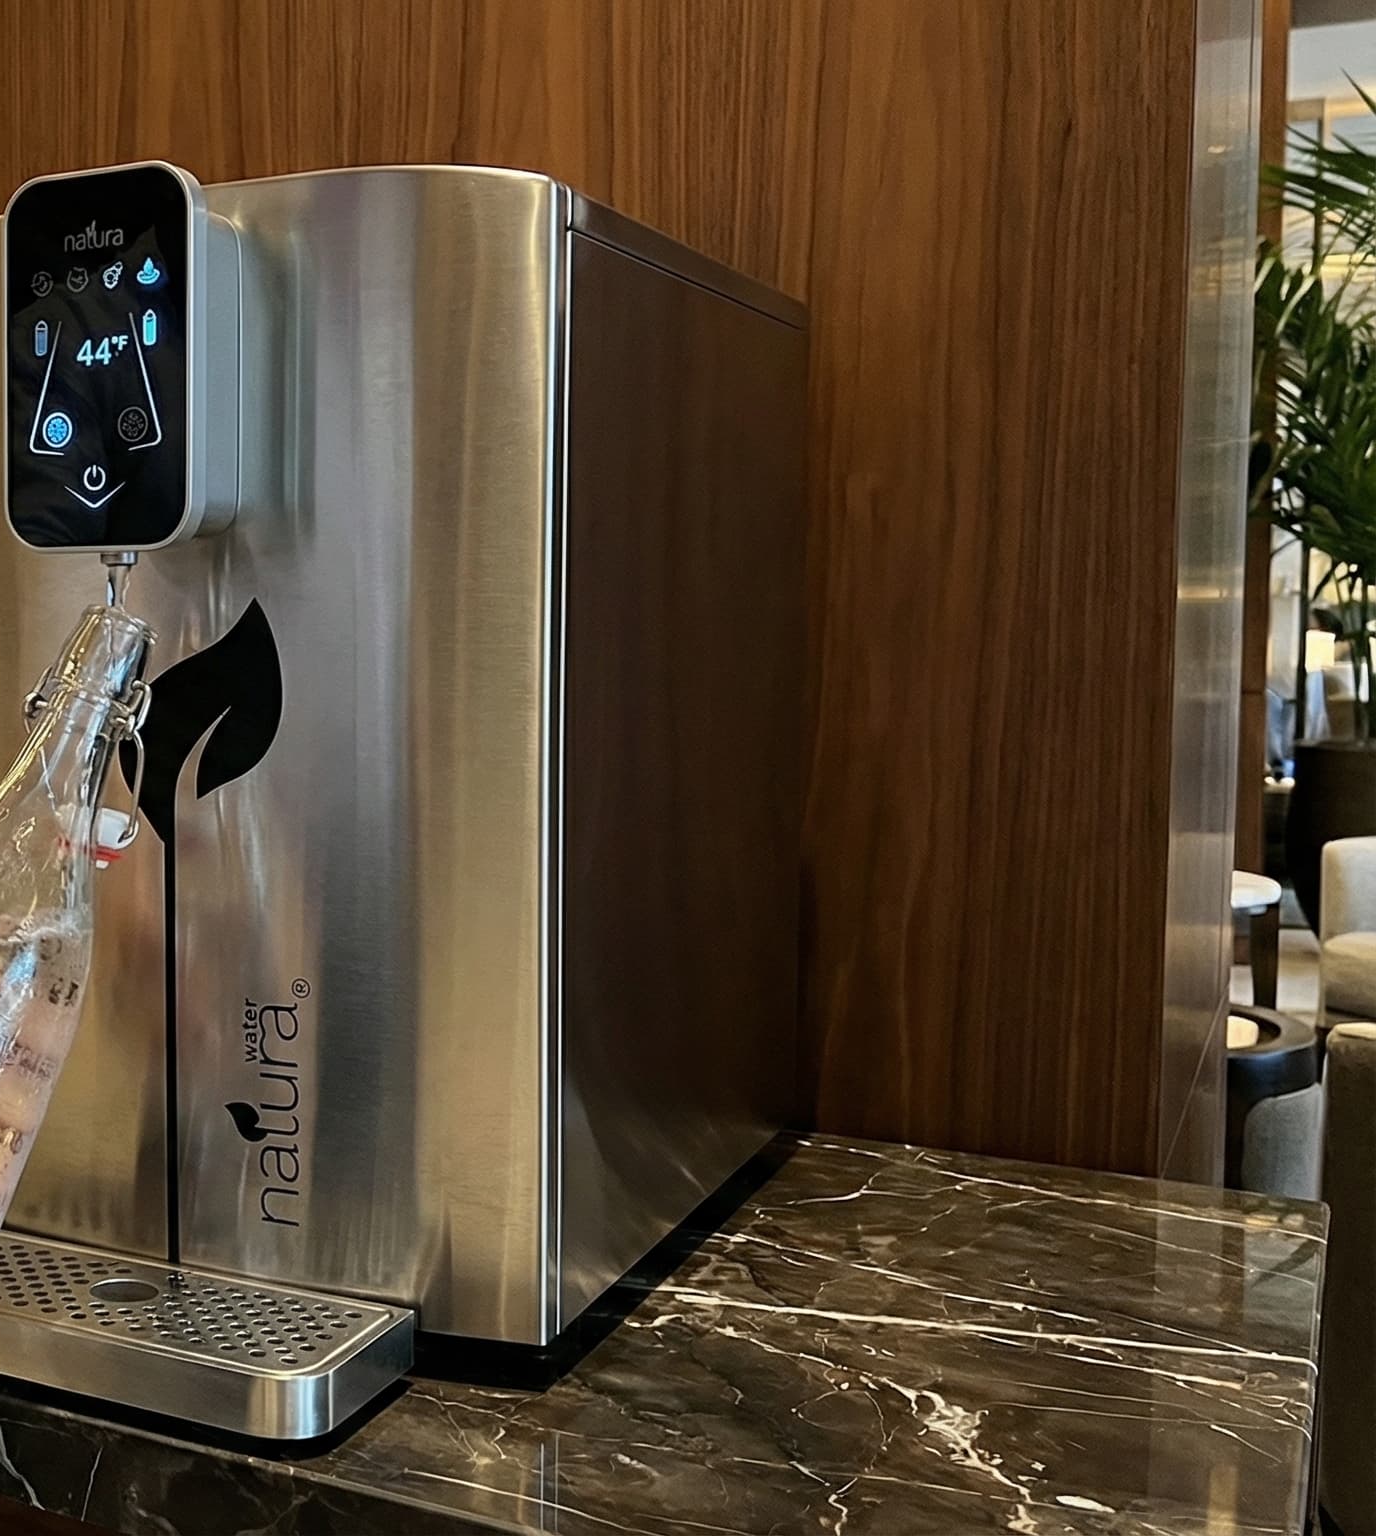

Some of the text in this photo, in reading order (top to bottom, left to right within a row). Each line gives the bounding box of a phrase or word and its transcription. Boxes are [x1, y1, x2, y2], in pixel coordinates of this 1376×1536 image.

[64, 221, 124, 252] natura
[76, 335, 129, 367] 44°F
[242, 998, 258, 1062] water
